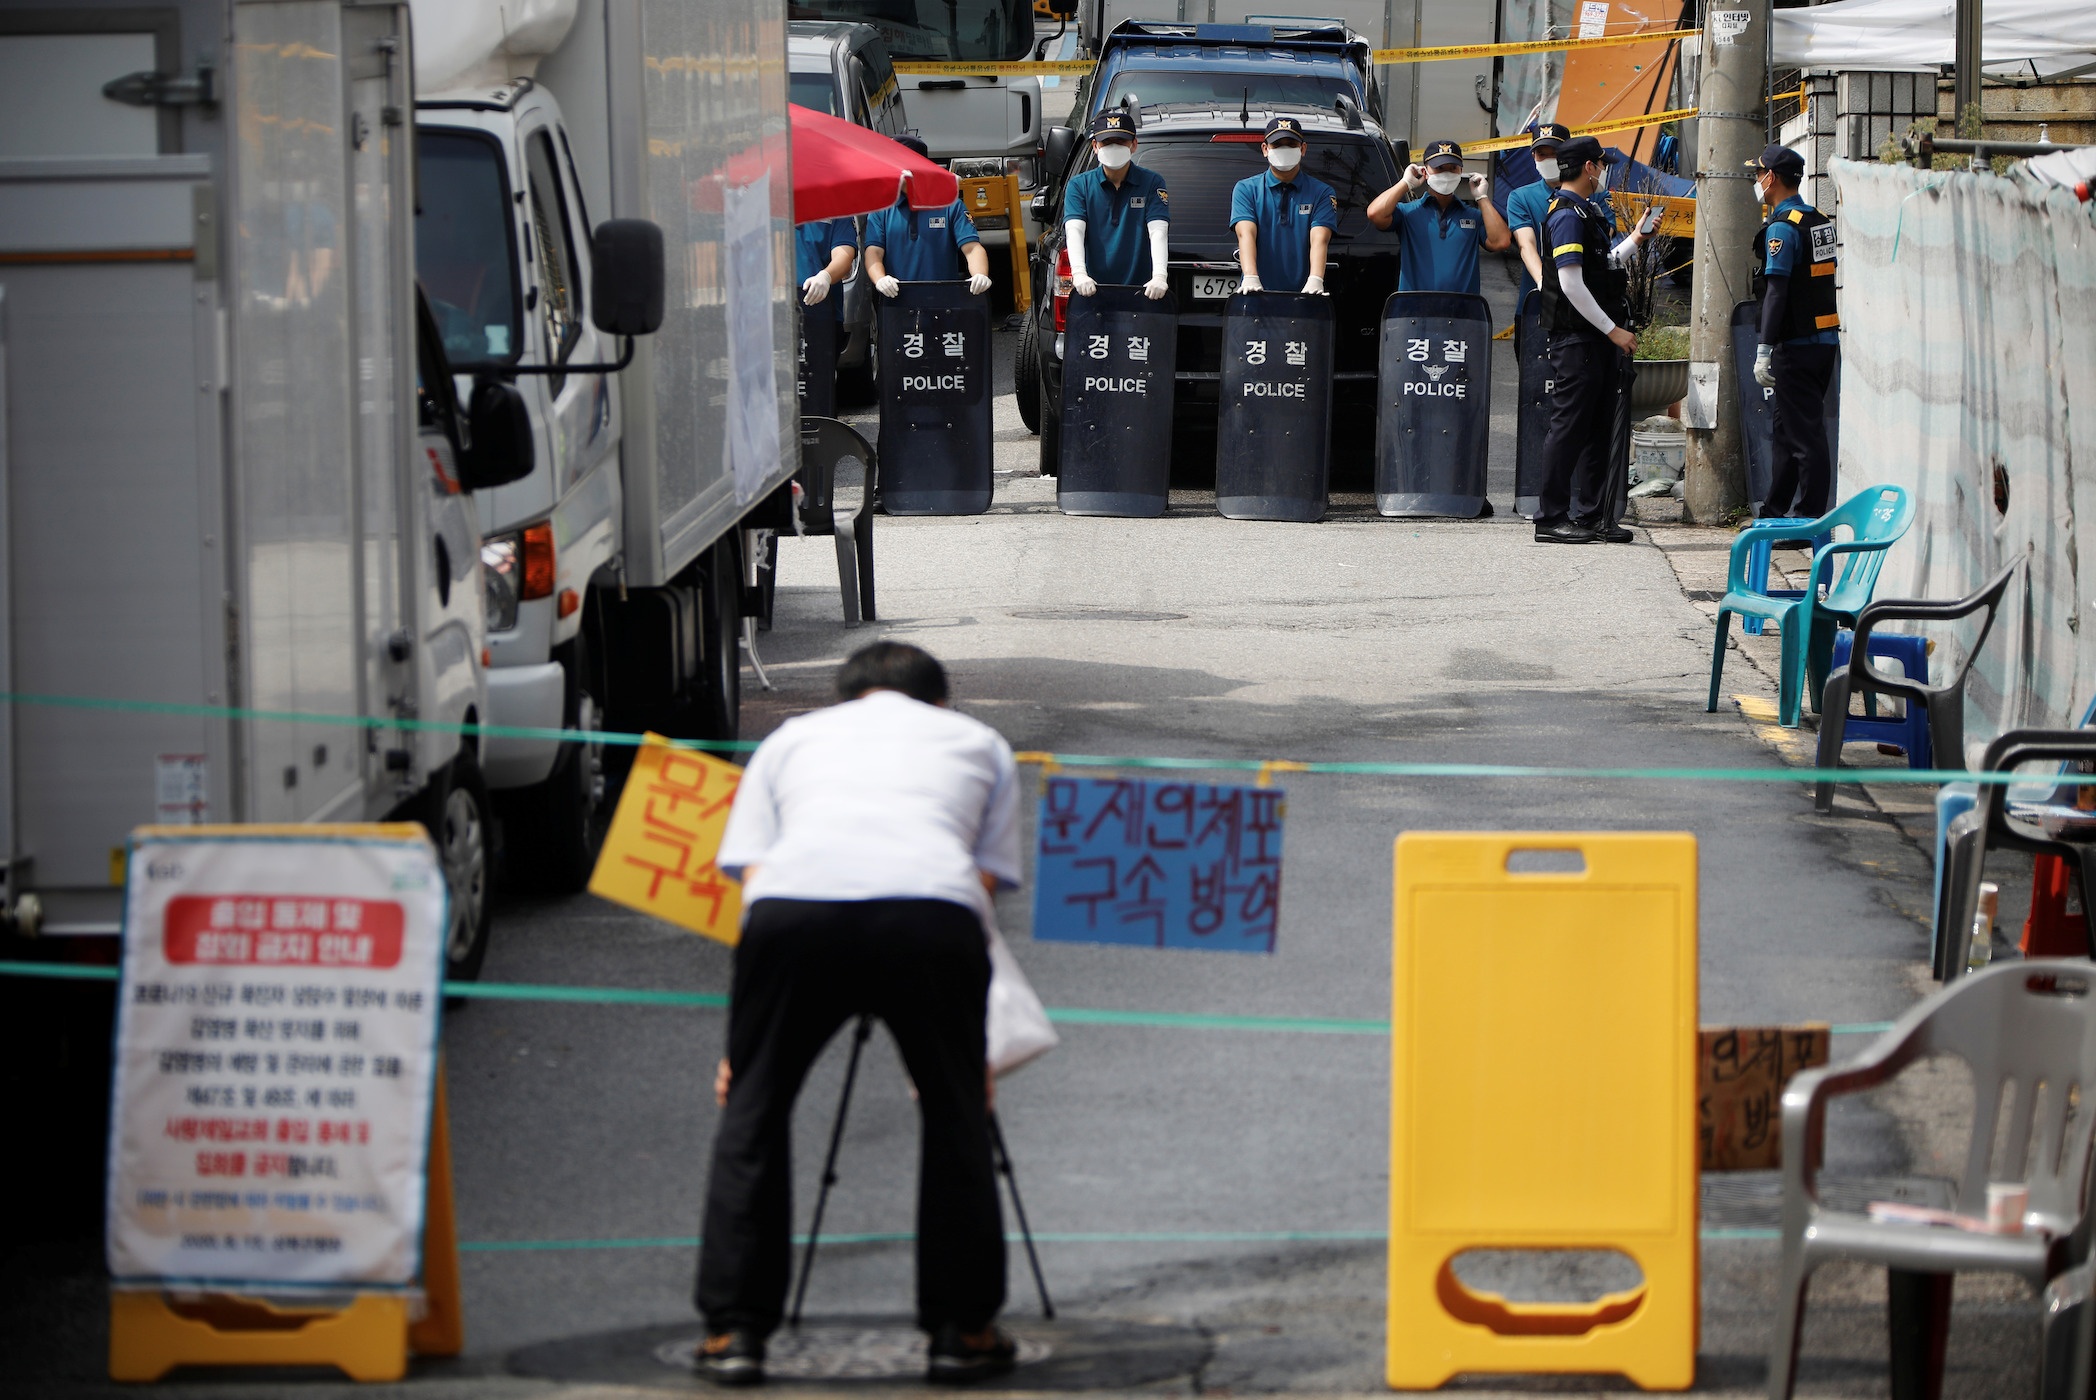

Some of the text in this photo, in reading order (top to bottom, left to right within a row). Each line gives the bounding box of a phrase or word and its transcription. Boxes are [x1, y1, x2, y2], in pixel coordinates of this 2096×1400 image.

[1723, 12, 1749, 22] 인터넷
[1587, 124, 1614, 134] 출입금지
[1471, 143, 1499, 151] 출입금지
[1812, 227, 1835, 246] 경찰
[1815, 246, 1835, 257] POLICE
[903, 376, 965, 391] POLICE
[1085, 377, 1147, 393] POLICE
[1243, 382, 1306, 398] POLICE
[1404, 382, 1466, 397] POLICE
[1064, 853, 1283, 955] 구속 방역
[1711, 1029, 1814, 1096] 인체포
